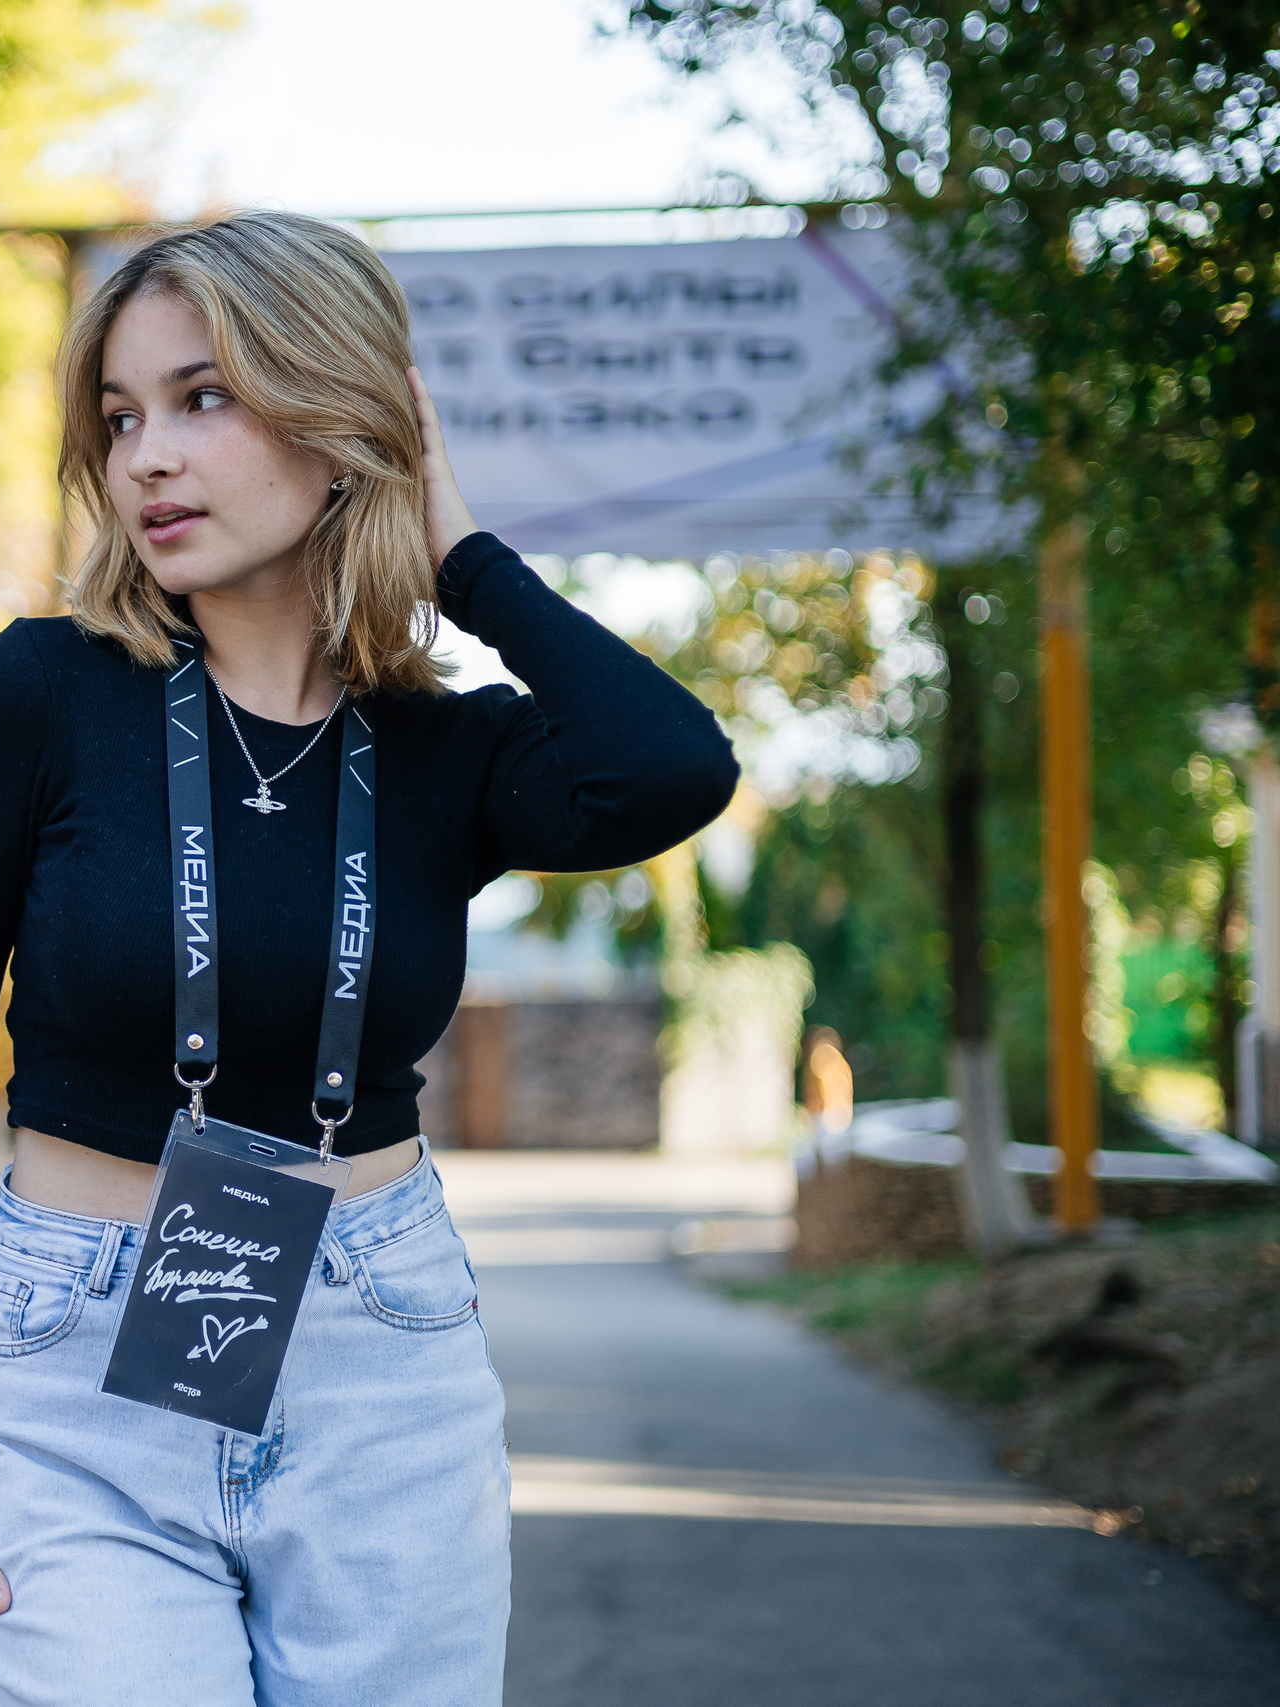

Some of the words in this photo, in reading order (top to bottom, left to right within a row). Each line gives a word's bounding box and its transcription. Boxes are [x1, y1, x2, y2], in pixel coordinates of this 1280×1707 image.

[180, 825, 211, 979] МЕДИА
[334, 851, 372, 1000] МЕДИА
[160, 1203, 281, 1263] Сонечка
[222, 1185, 270, 1206] МЕДИА
